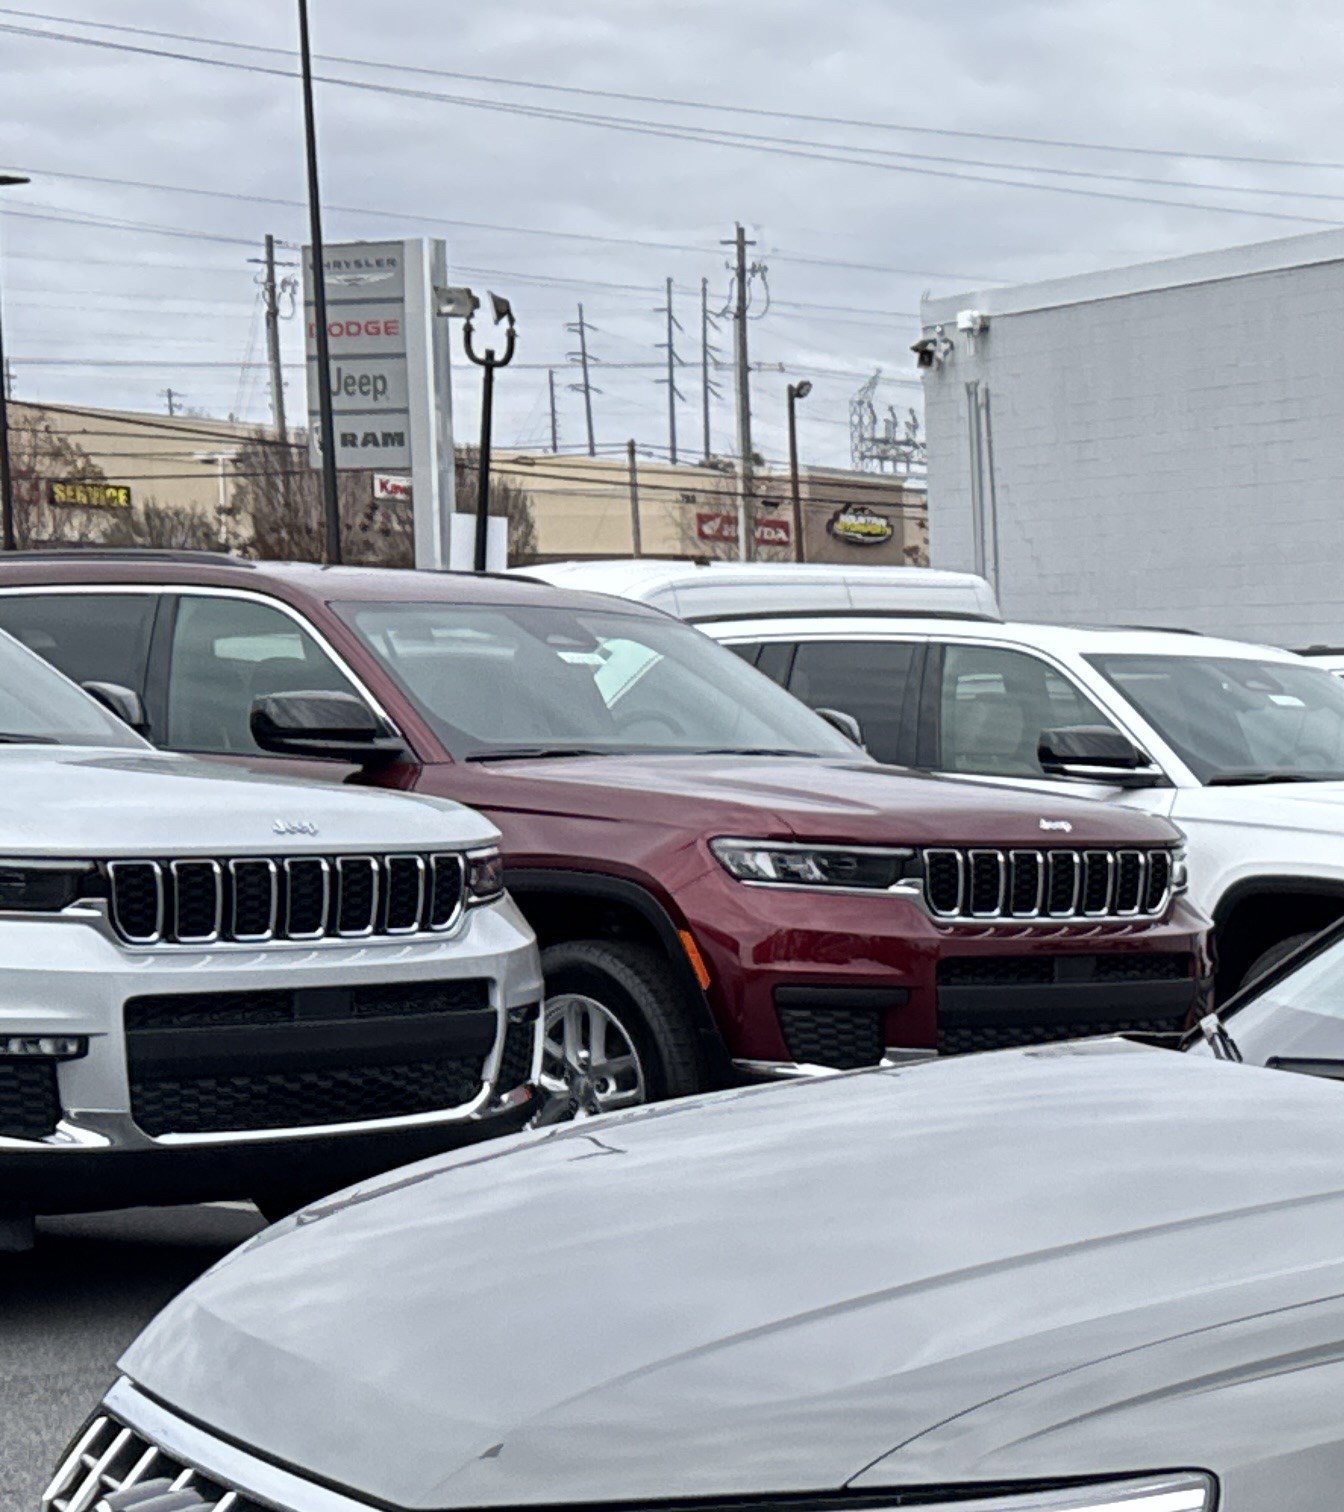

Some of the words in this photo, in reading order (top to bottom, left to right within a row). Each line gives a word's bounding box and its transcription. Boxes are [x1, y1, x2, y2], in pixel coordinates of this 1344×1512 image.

[309, 257, 397, 271] HRYSLER
[331, 366, 388, 402] Jeep
[340, 430, 405, 449] RAM
[52, 483, 129, 507] SERVICE
